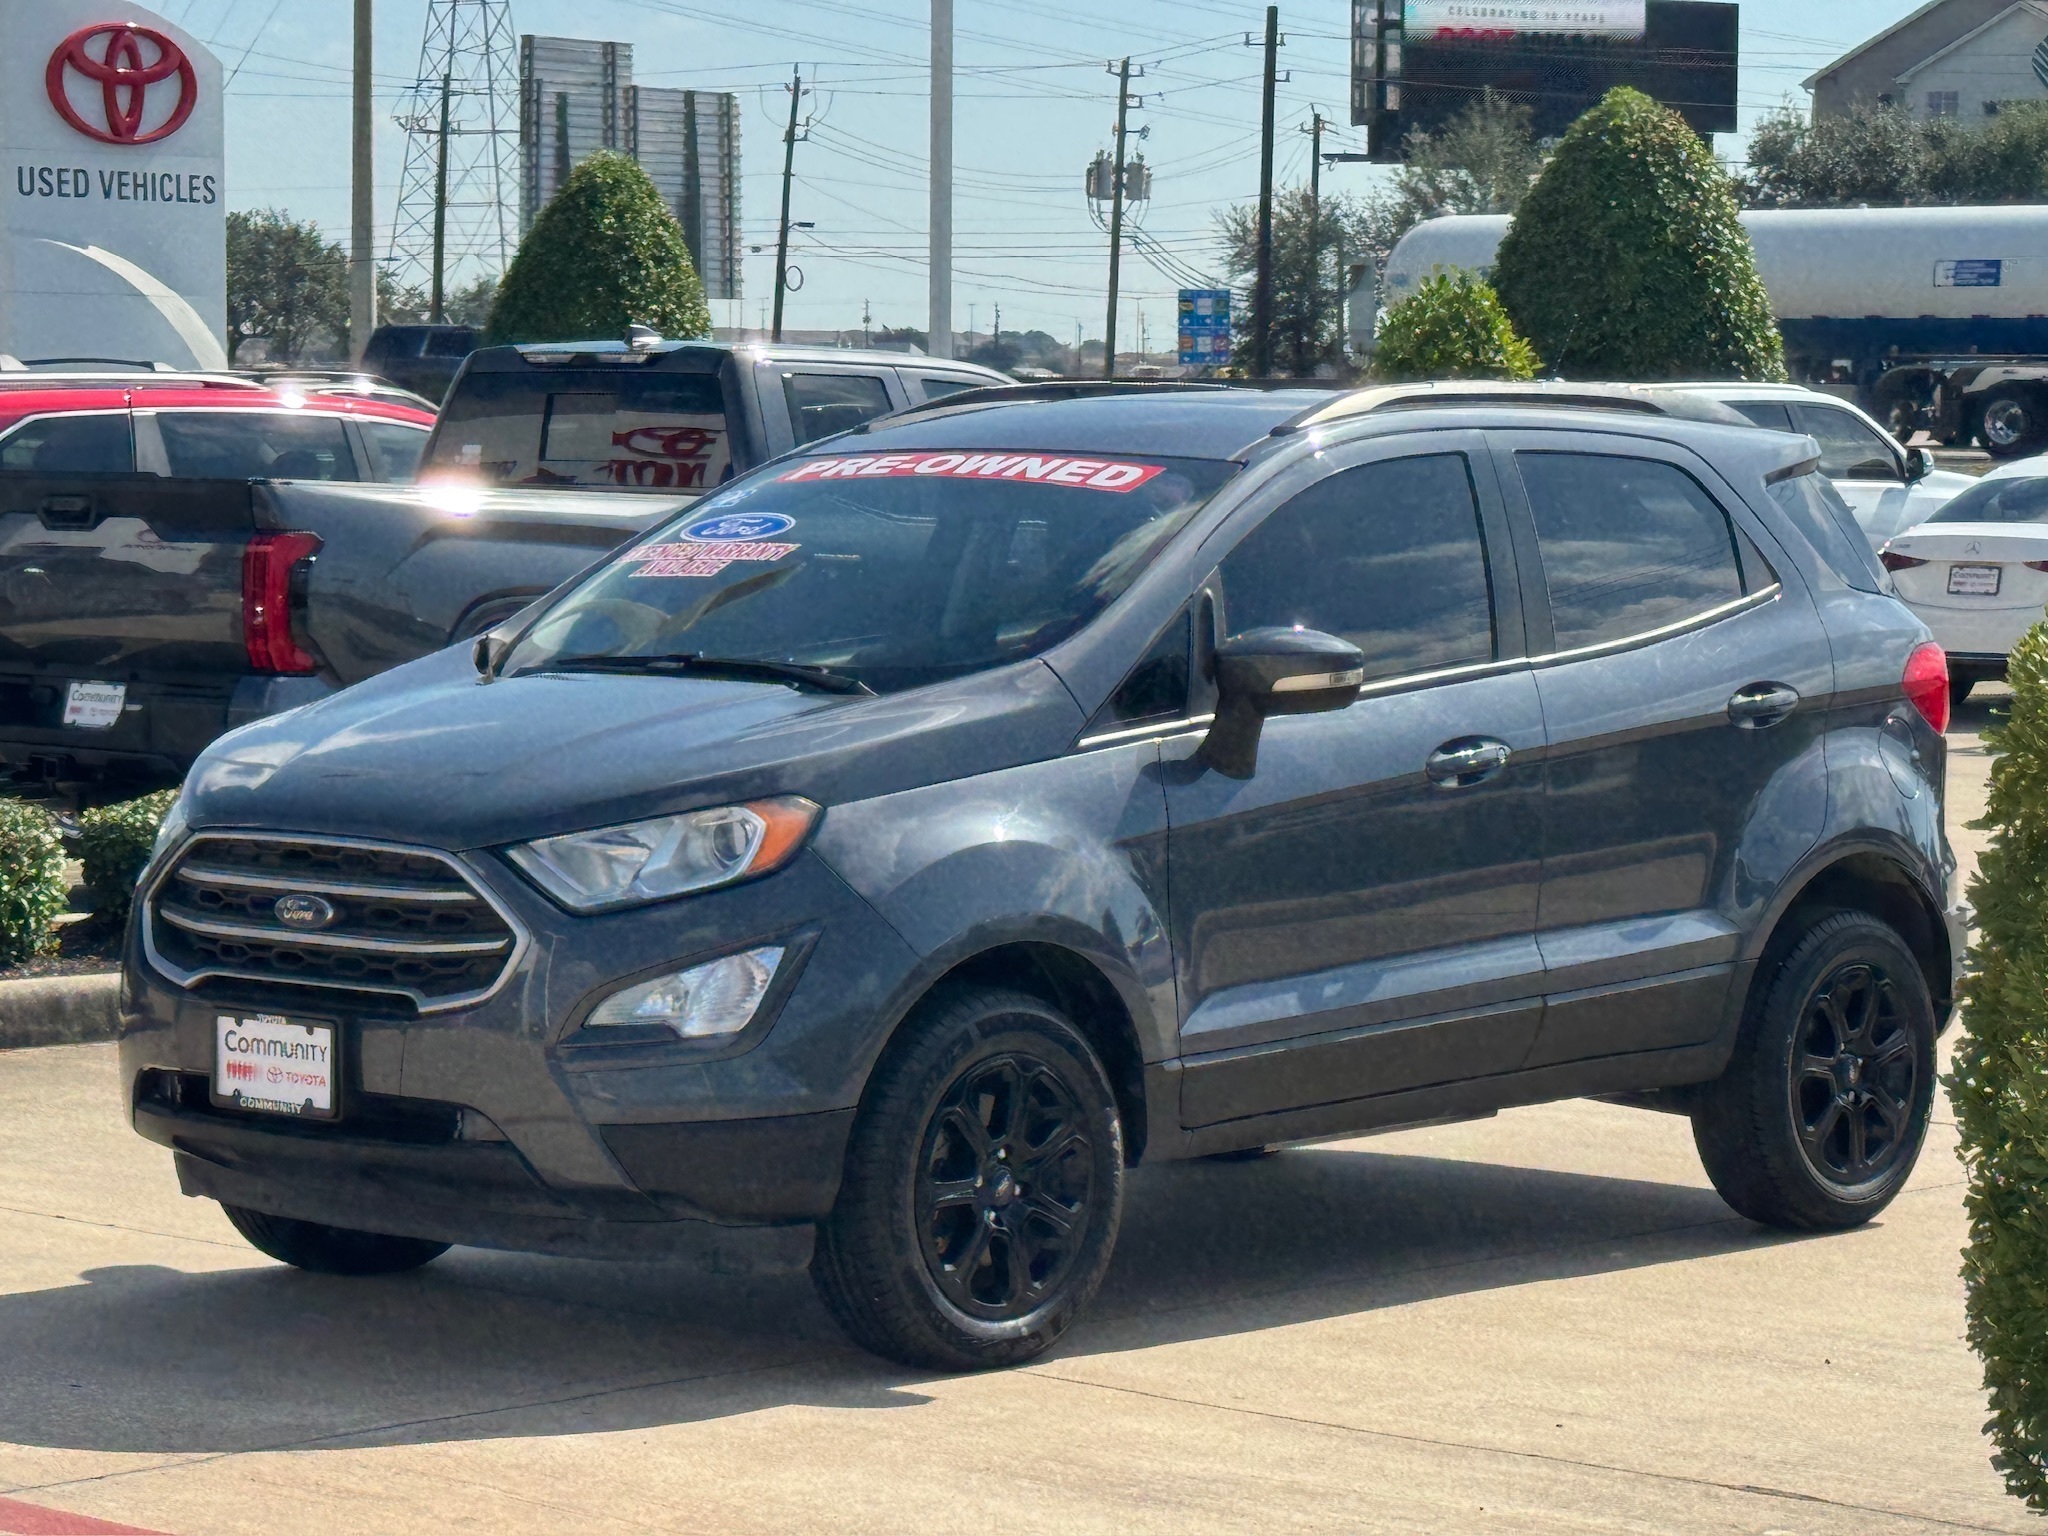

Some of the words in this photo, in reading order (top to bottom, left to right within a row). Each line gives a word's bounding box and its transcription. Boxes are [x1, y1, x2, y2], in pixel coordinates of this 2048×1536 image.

[17, 166, 90, 197] USED
[98, 170, 217, 205] VEHICLES
[785, 454, 1144, 487] PRE-OWNED
[285, 1071, 327, 1087] TOYOTA
[240, 1096, 302, 1115] COMMUNITY
